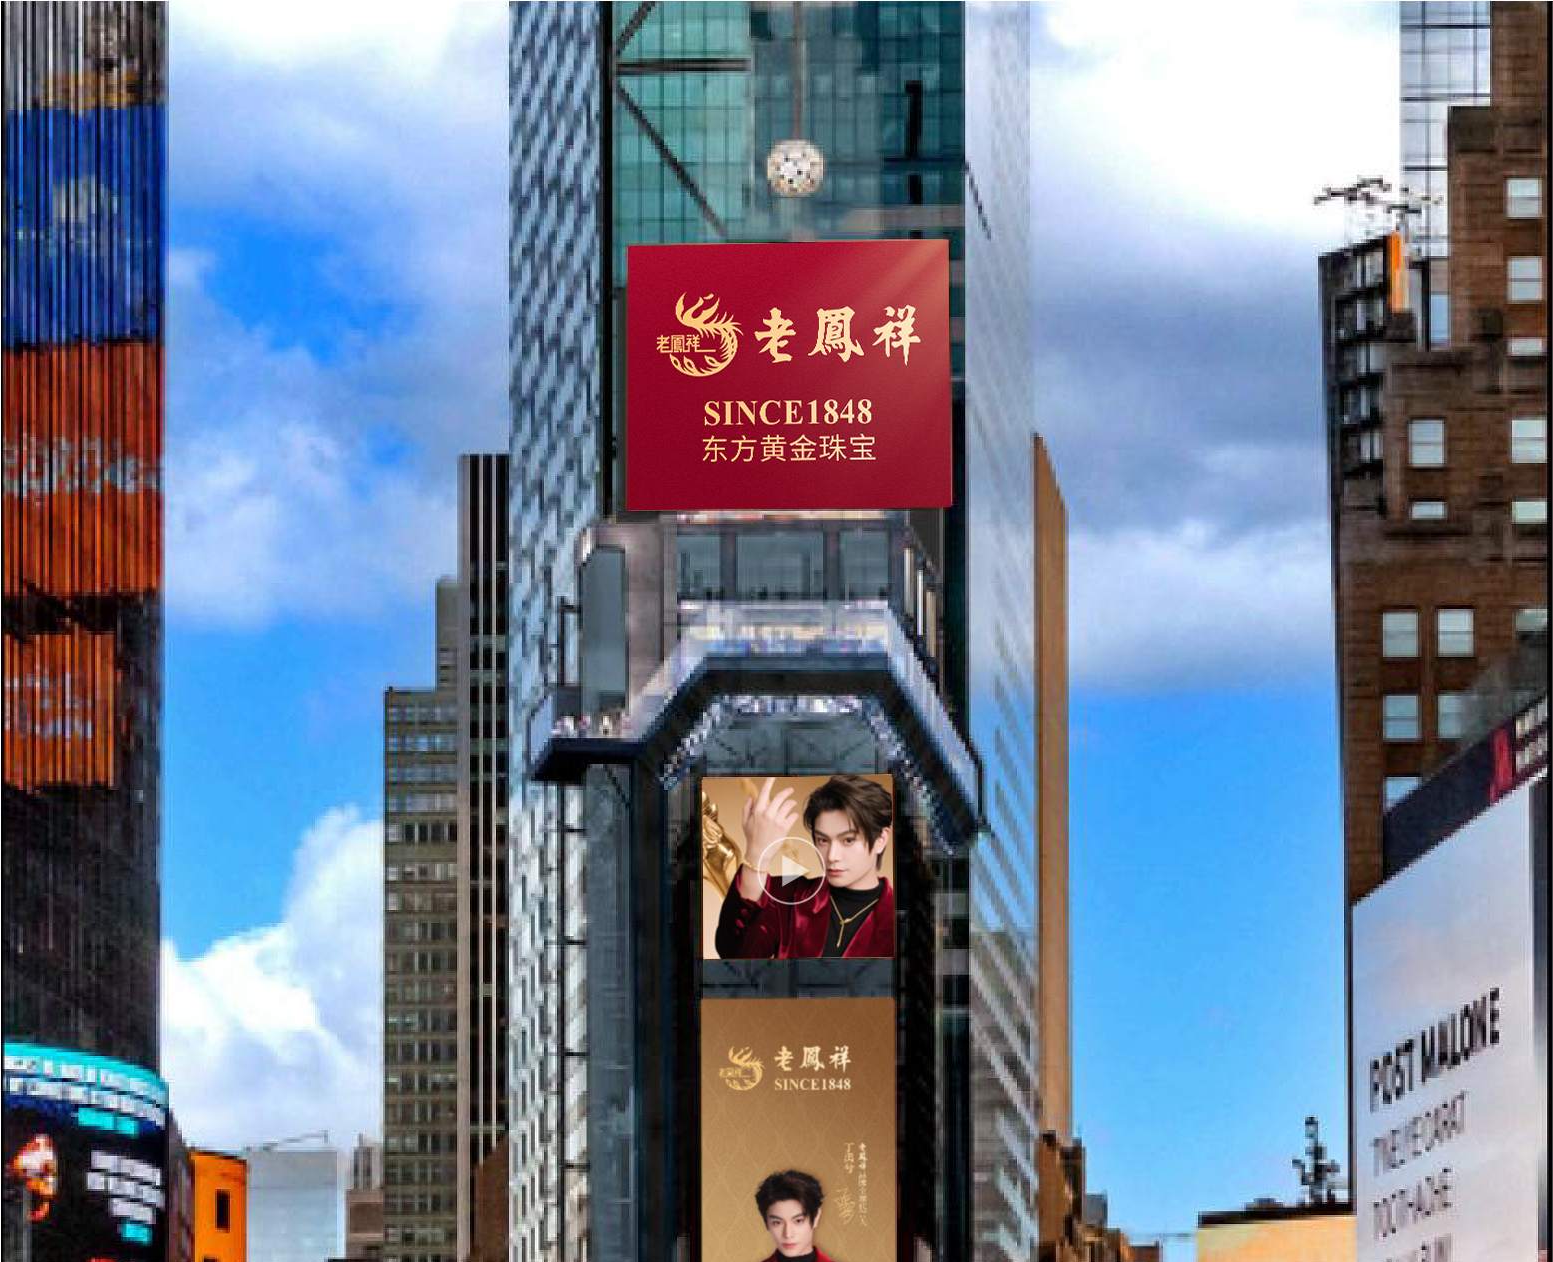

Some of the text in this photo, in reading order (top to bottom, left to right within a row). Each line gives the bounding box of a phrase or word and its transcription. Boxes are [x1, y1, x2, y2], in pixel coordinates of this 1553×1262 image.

[754, 305, 921, 366] 老鳳祥
[704, 399, 872, 426] SINCE1848
[702, 434, 876, 463] 东方黄金珠宝
[774, 1078, 851, 1091] SINCE1848
